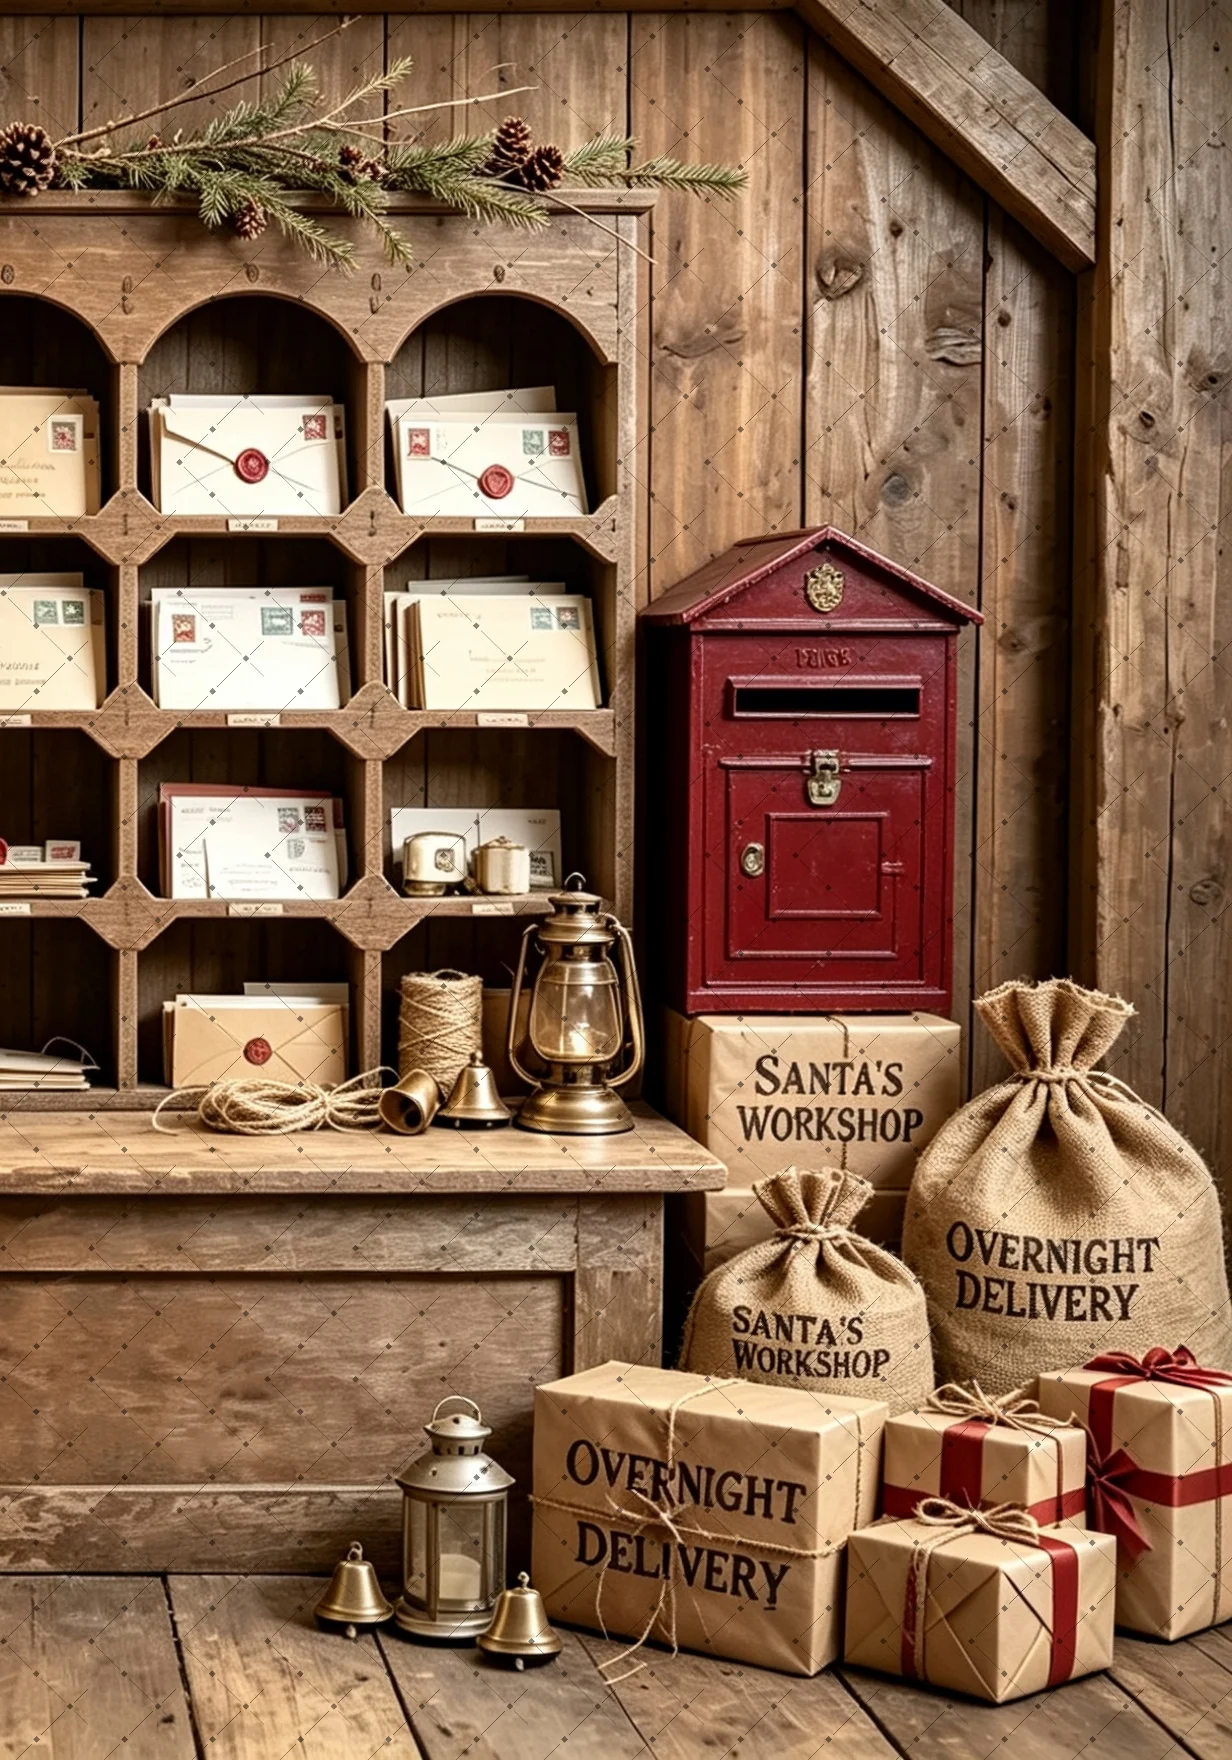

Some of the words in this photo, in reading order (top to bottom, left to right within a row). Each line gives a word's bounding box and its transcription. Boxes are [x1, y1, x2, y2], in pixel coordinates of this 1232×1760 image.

[755, 1054, 903, 1097] SANTA'S
[736, 1105, 924, 1142] WORKSHOP
[946, 1221, 1161, 1275] OVERNIGHT
[955, 1269, 1140, 1322] DELIVERY
[732, 1305, 864, 1346] SANTA'S
[732, 1338, 890, 1378] WORKSHOP
[566, 1439, 807, 1524] OVERNIGHT
[575, 1521, 791, 1611] DELIVERY
